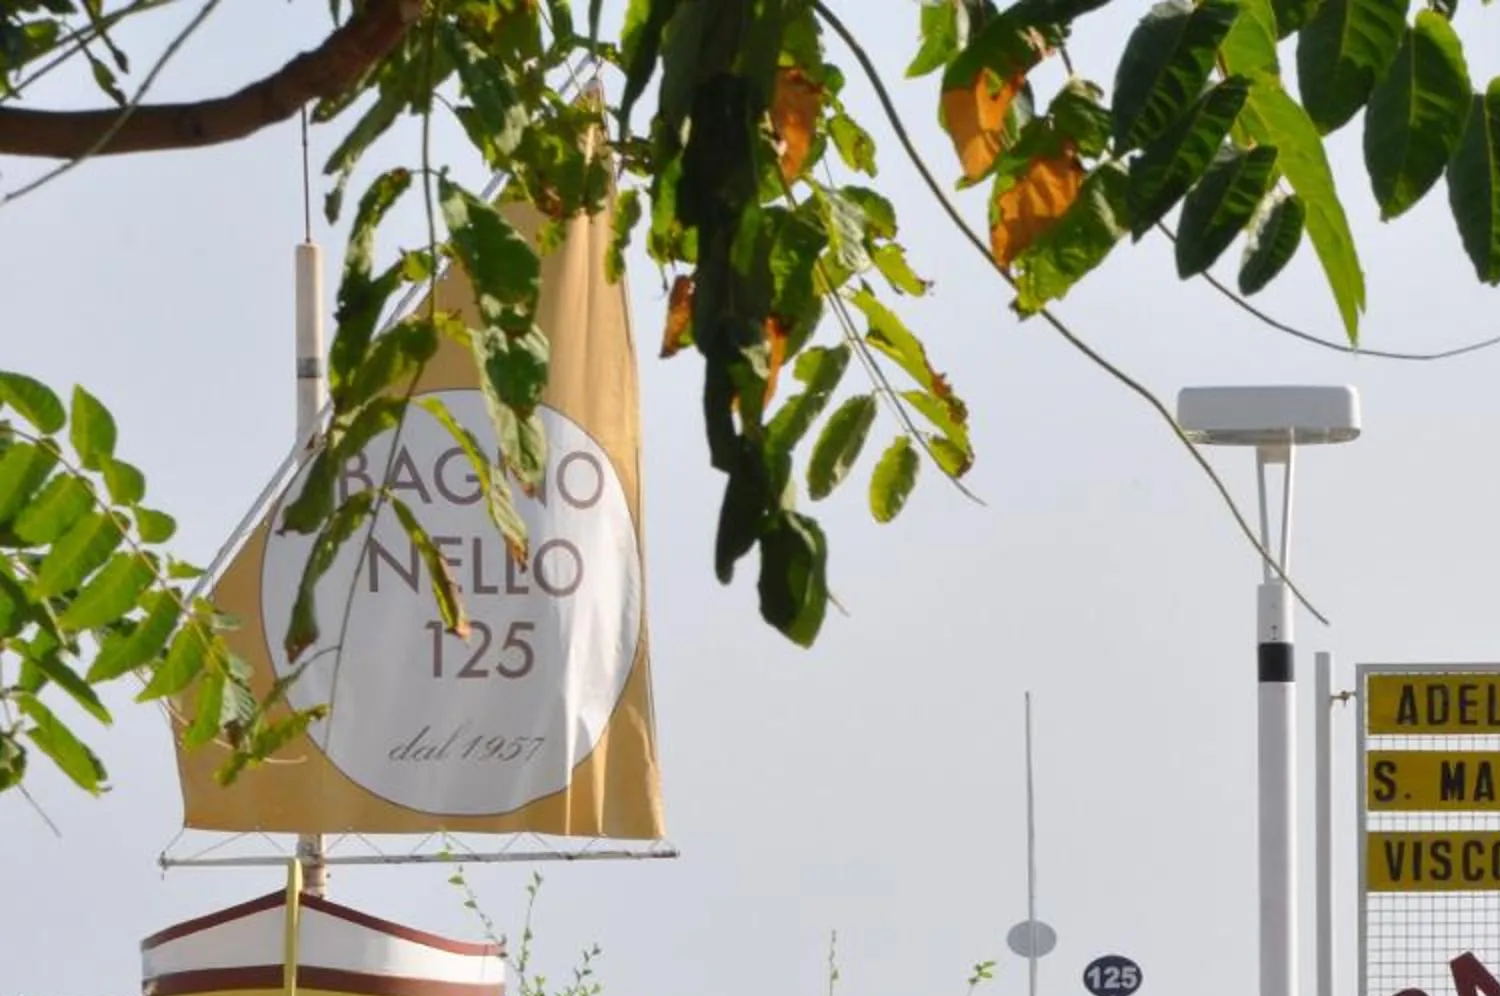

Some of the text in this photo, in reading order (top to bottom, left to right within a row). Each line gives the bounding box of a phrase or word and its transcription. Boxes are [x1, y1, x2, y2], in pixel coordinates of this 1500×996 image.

[425, 621, 535, 680] 125
[461, 734, 546, 763] 1957
[1373, 760, 1412, 802] S.
[1088, 966, 1138, 989] 125
